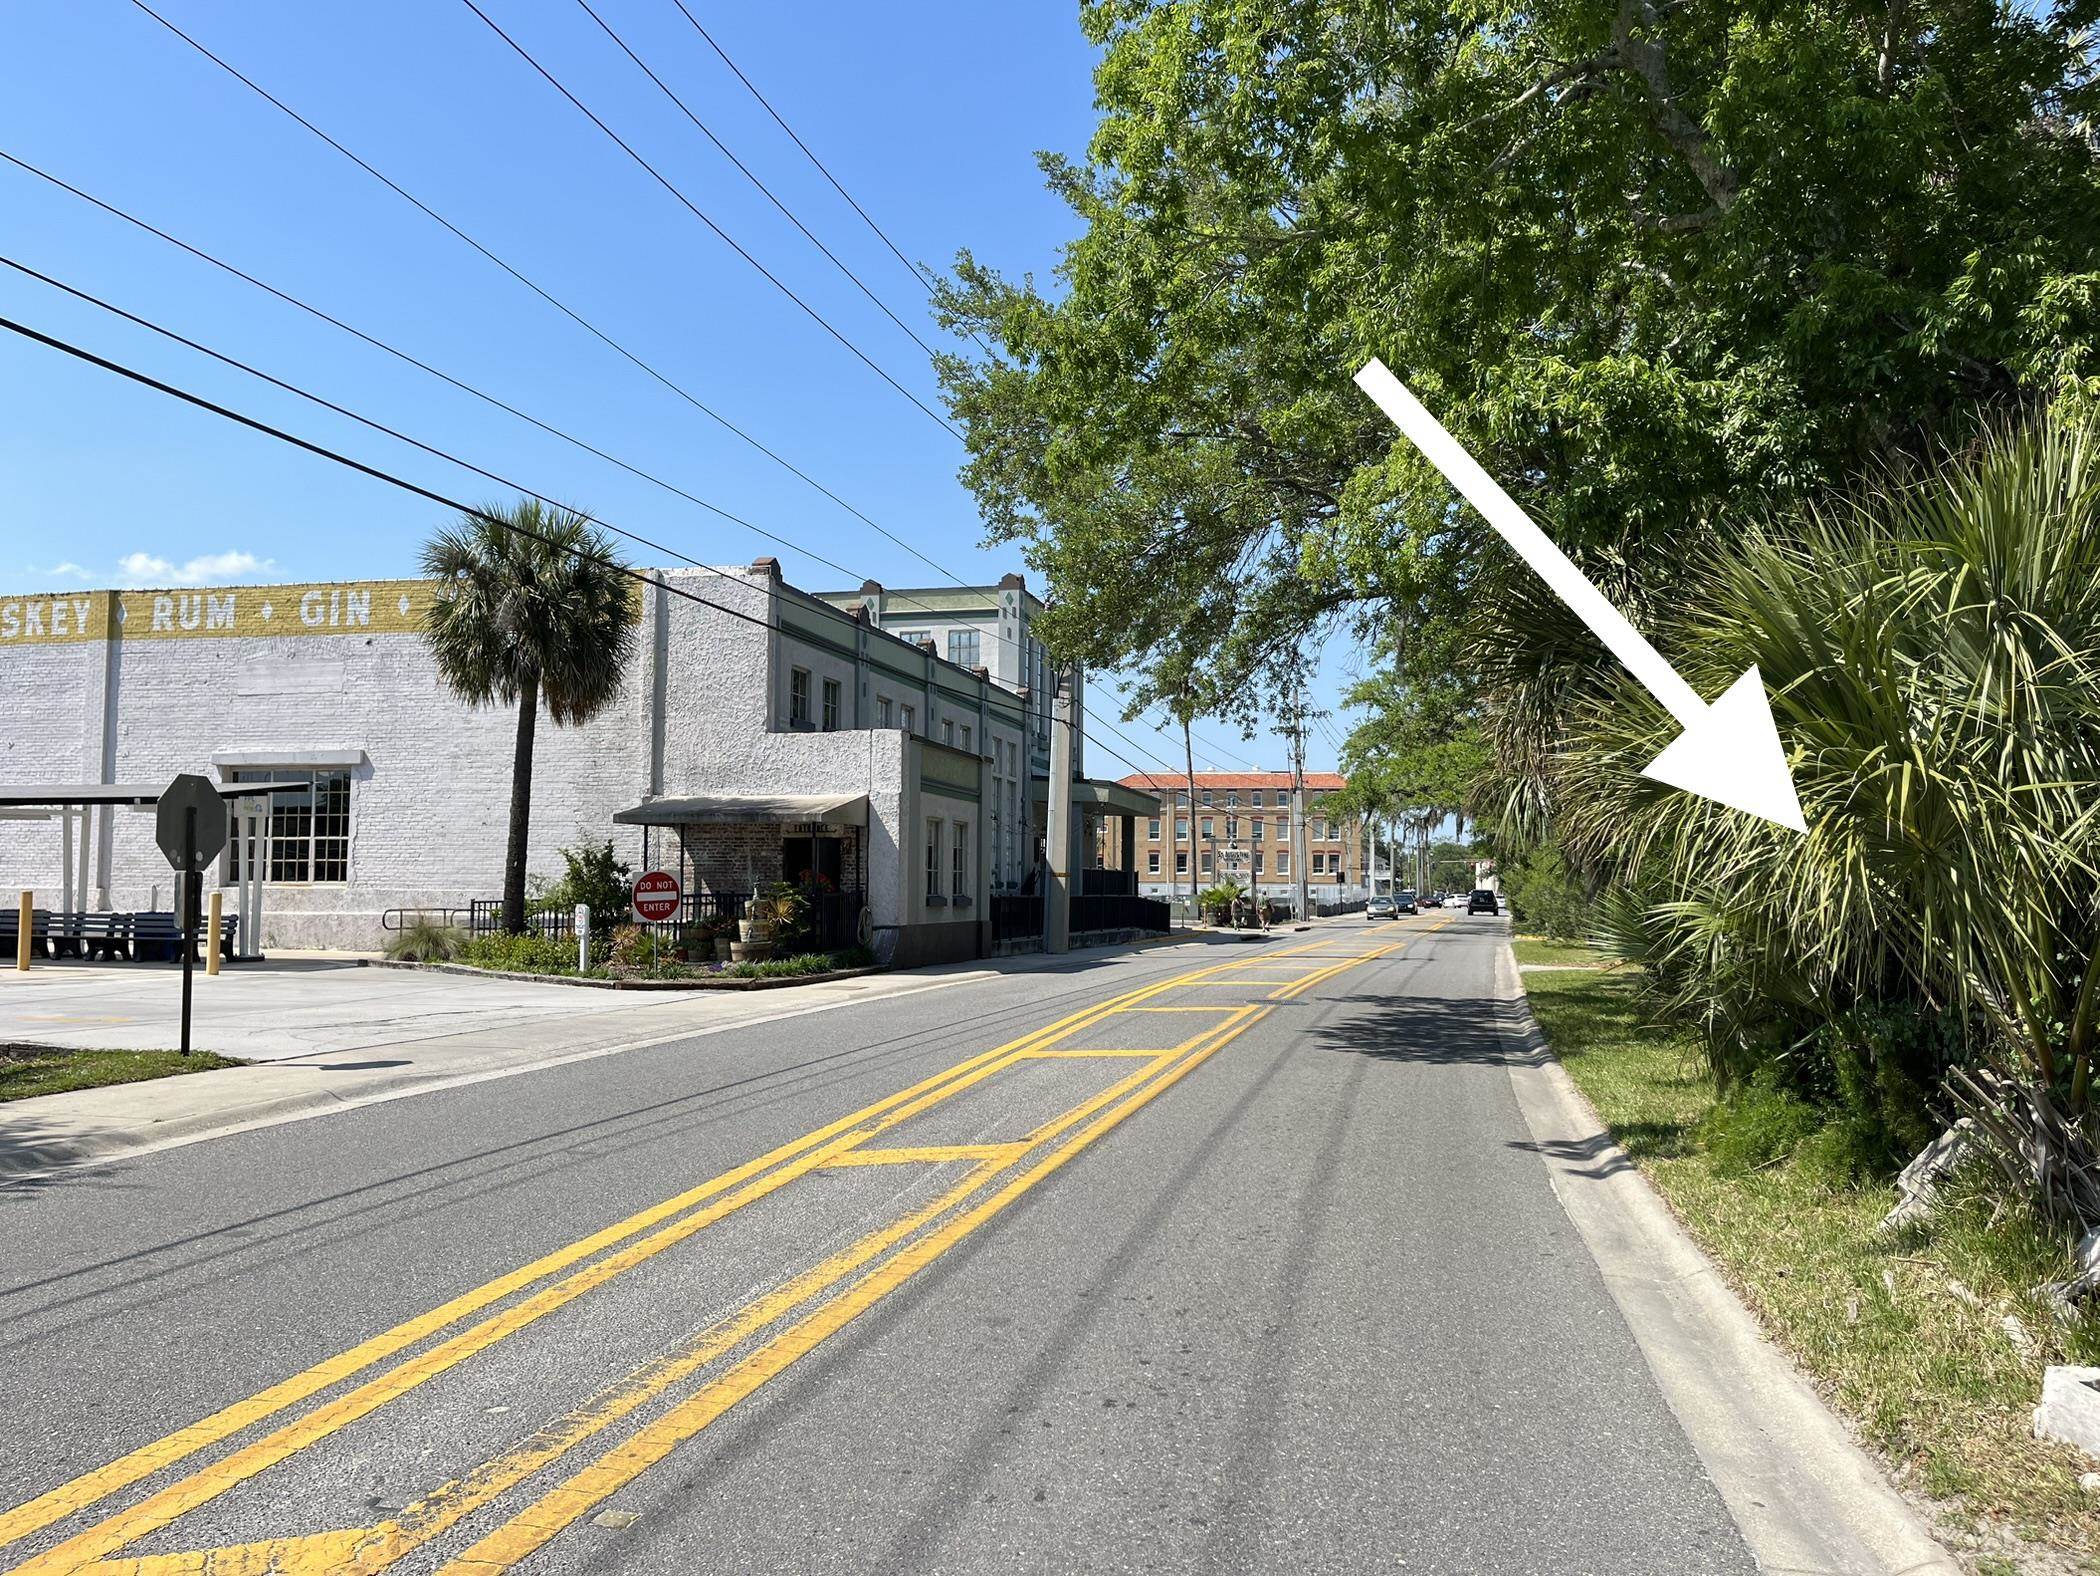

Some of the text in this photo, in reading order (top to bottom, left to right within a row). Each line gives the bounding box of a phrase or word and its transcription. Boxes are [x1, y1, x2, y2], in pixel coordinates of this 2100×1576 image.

[0, 590, 370, 637] SKEY RUM GIN
[640, 880, 673, 890] DO NOT
[643, 902, 671, 912] ENTER
